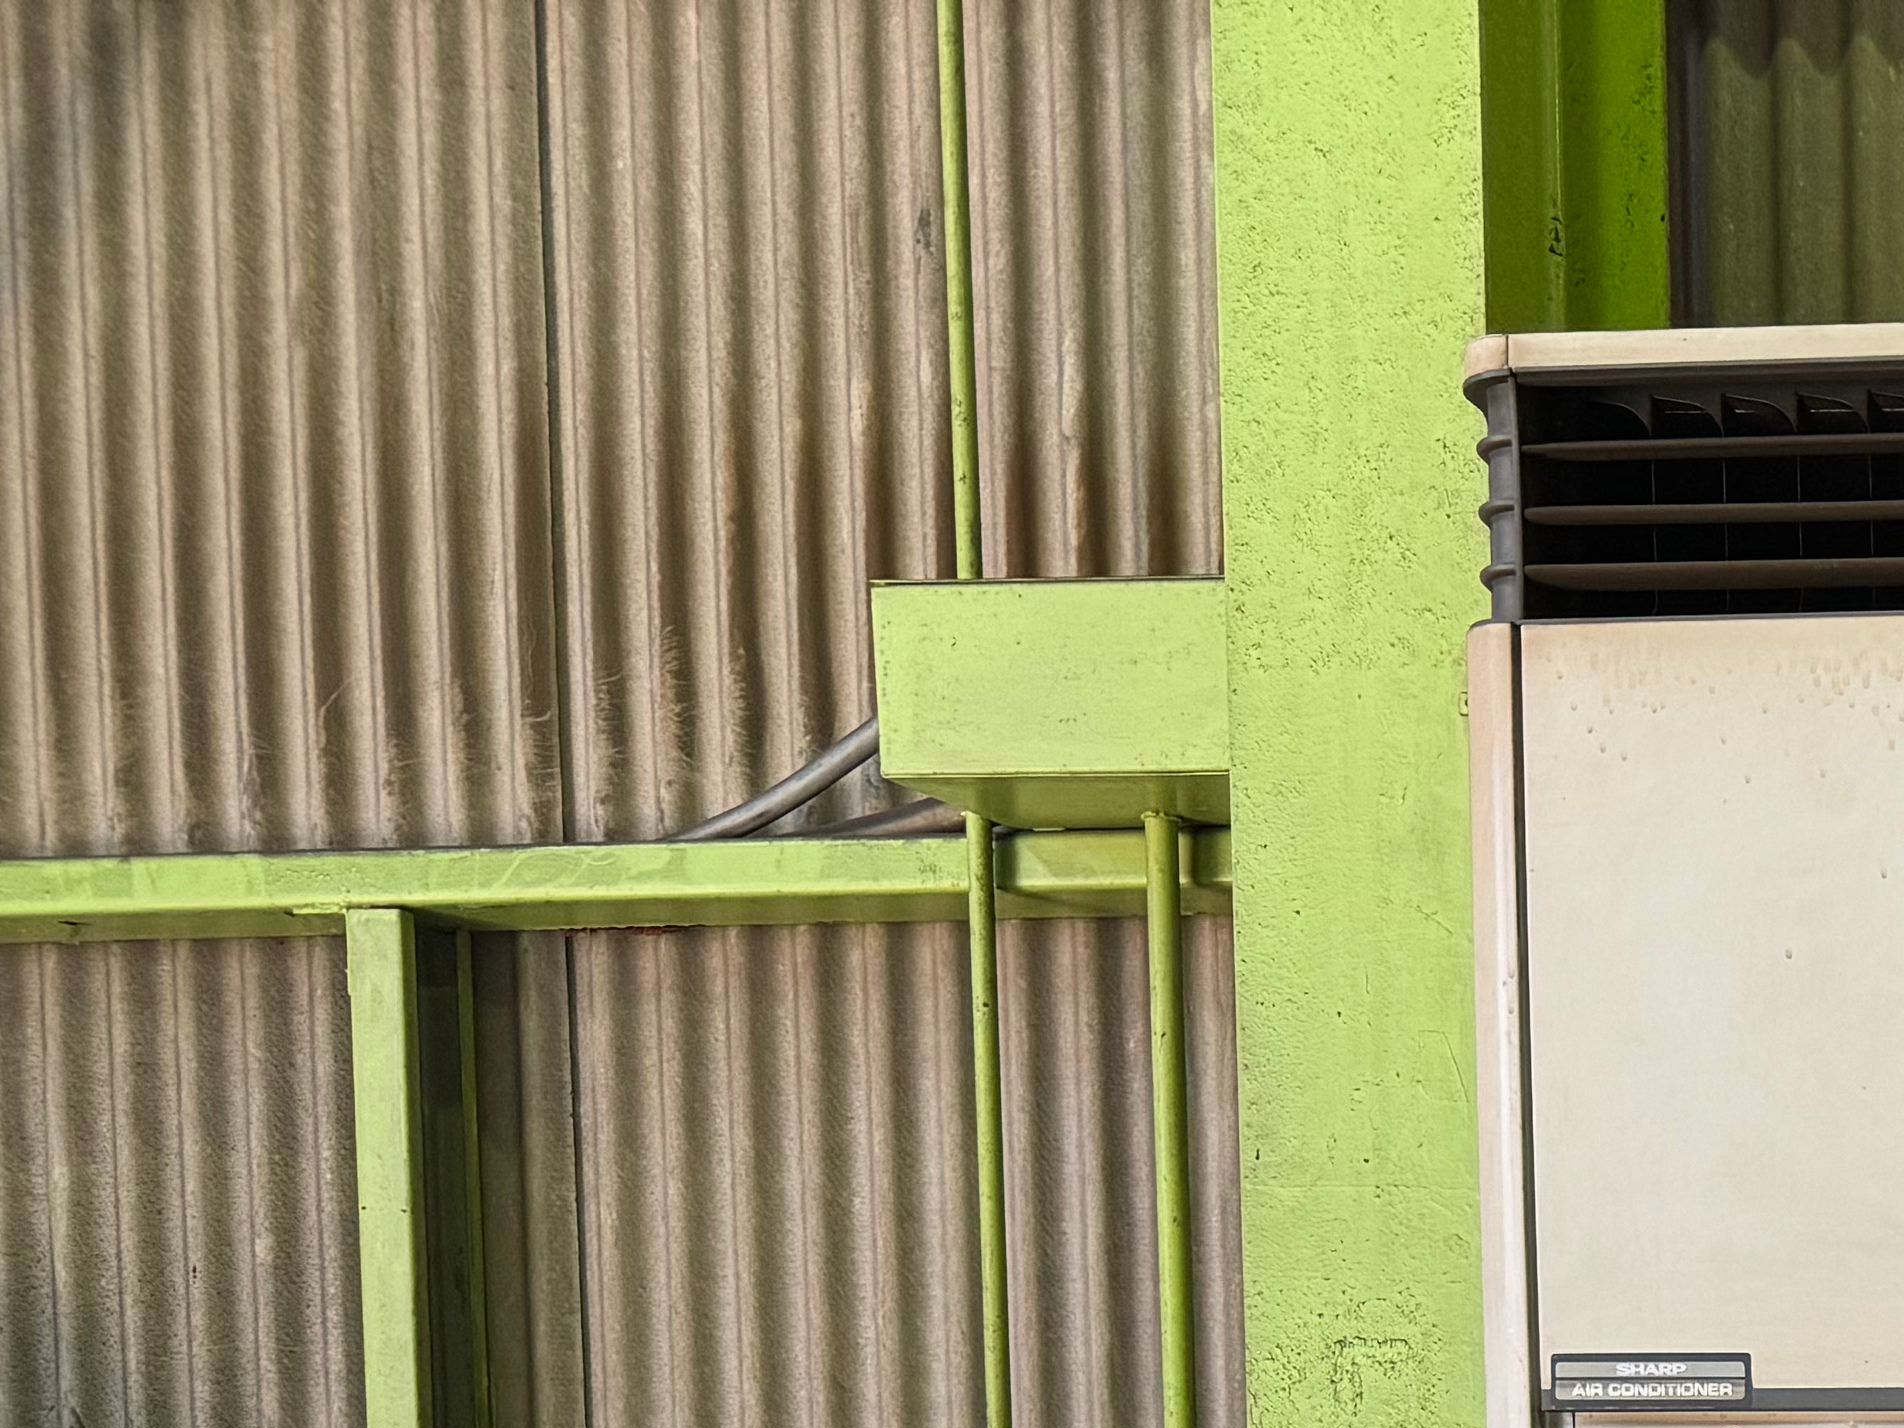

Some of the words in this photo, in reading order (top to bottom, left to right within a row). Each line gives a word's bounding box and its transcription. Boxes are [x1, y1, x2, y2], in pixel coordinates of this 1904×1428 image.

[1615, 1362, 1687, 1377] SHARP
[1572, 1383, 1603, 1397] AIR
[1608, 1383, 1733, 1398] CONDITIONER
